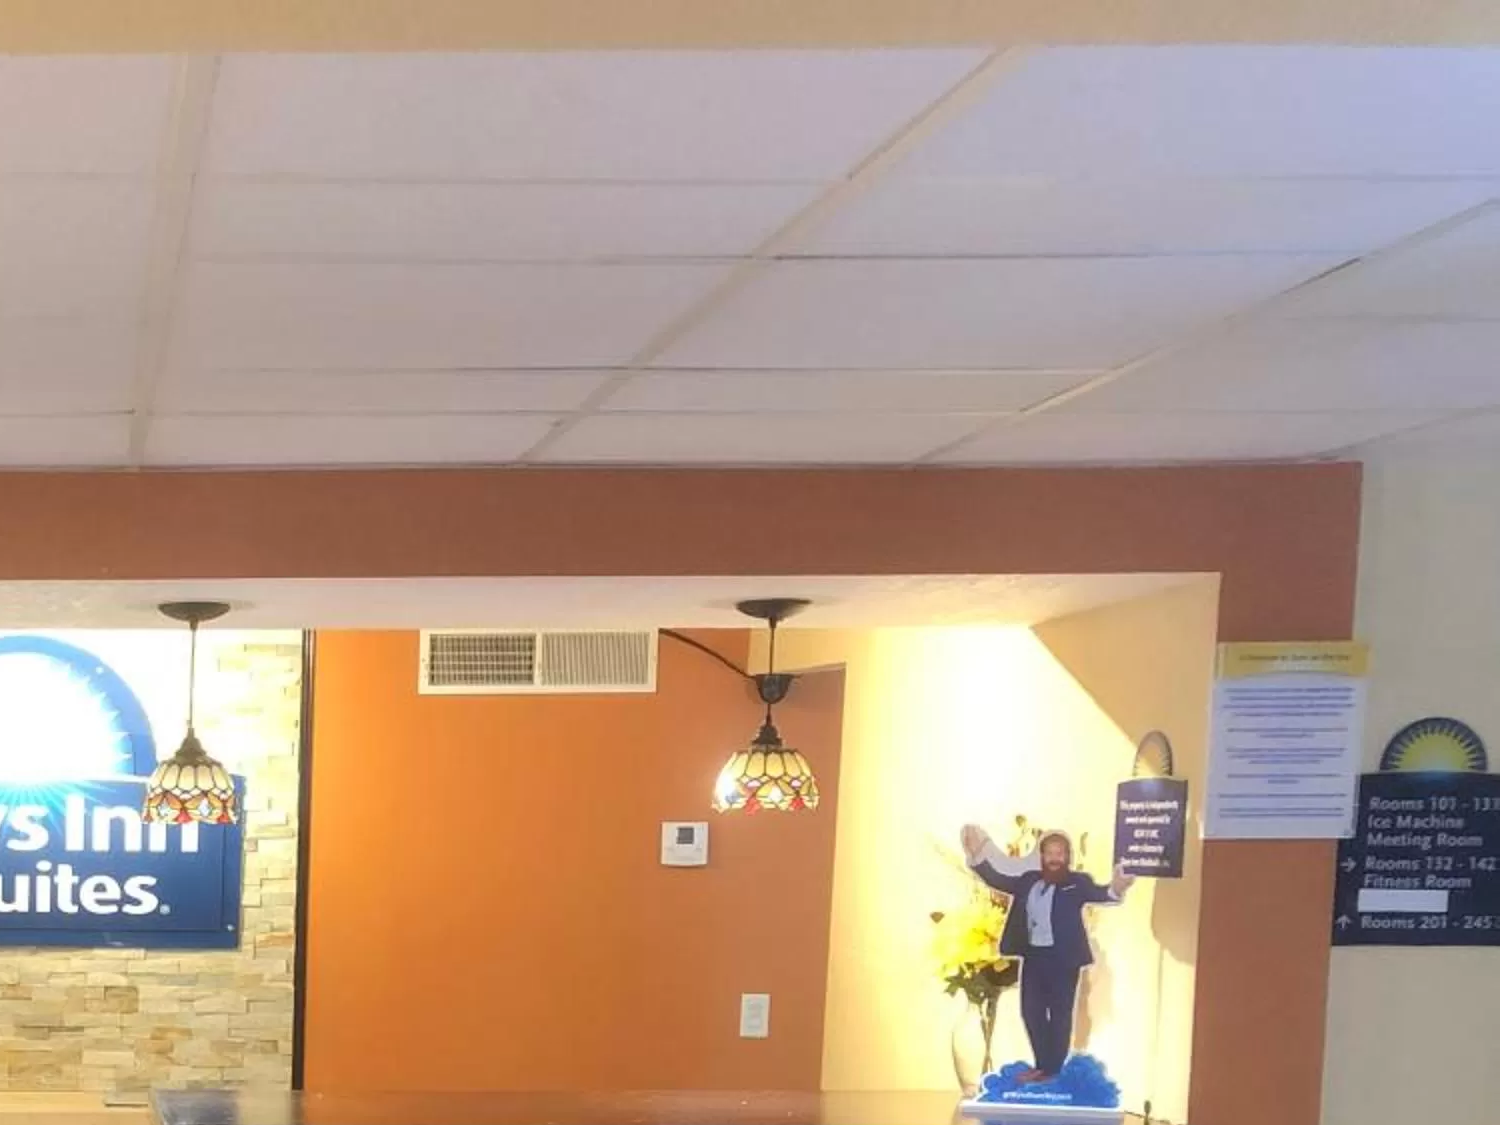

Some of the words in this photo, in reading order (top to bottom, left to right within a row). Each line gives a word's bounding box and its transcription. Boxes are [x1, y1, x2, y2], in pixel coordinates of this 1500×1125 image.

[1369, 797, 1425, 811] Rooms
[1430, 797, 1456, 811] 101
[66, 795, 198, 853] Inn
[1367, 814, 1390, 829] Ice
[1396, 813, 1464, 829] Machine
[1366, 832, 1432, 850] Meeting
[1437, 832, 1483, 847] Room
[1364, 856, 1421, 870] Rooms
[1426, 856, 1452, 870] 132
[1470, 856, 1496, 871] 142
[1363, 874, 1421, 888] Fitness
[1425, 874, 1472, 888] Room
[1361, 915, 1418, 929] Rooms
[1419, 915, 1446, 929] 201
[1463, 915, 1493, 929] 245
